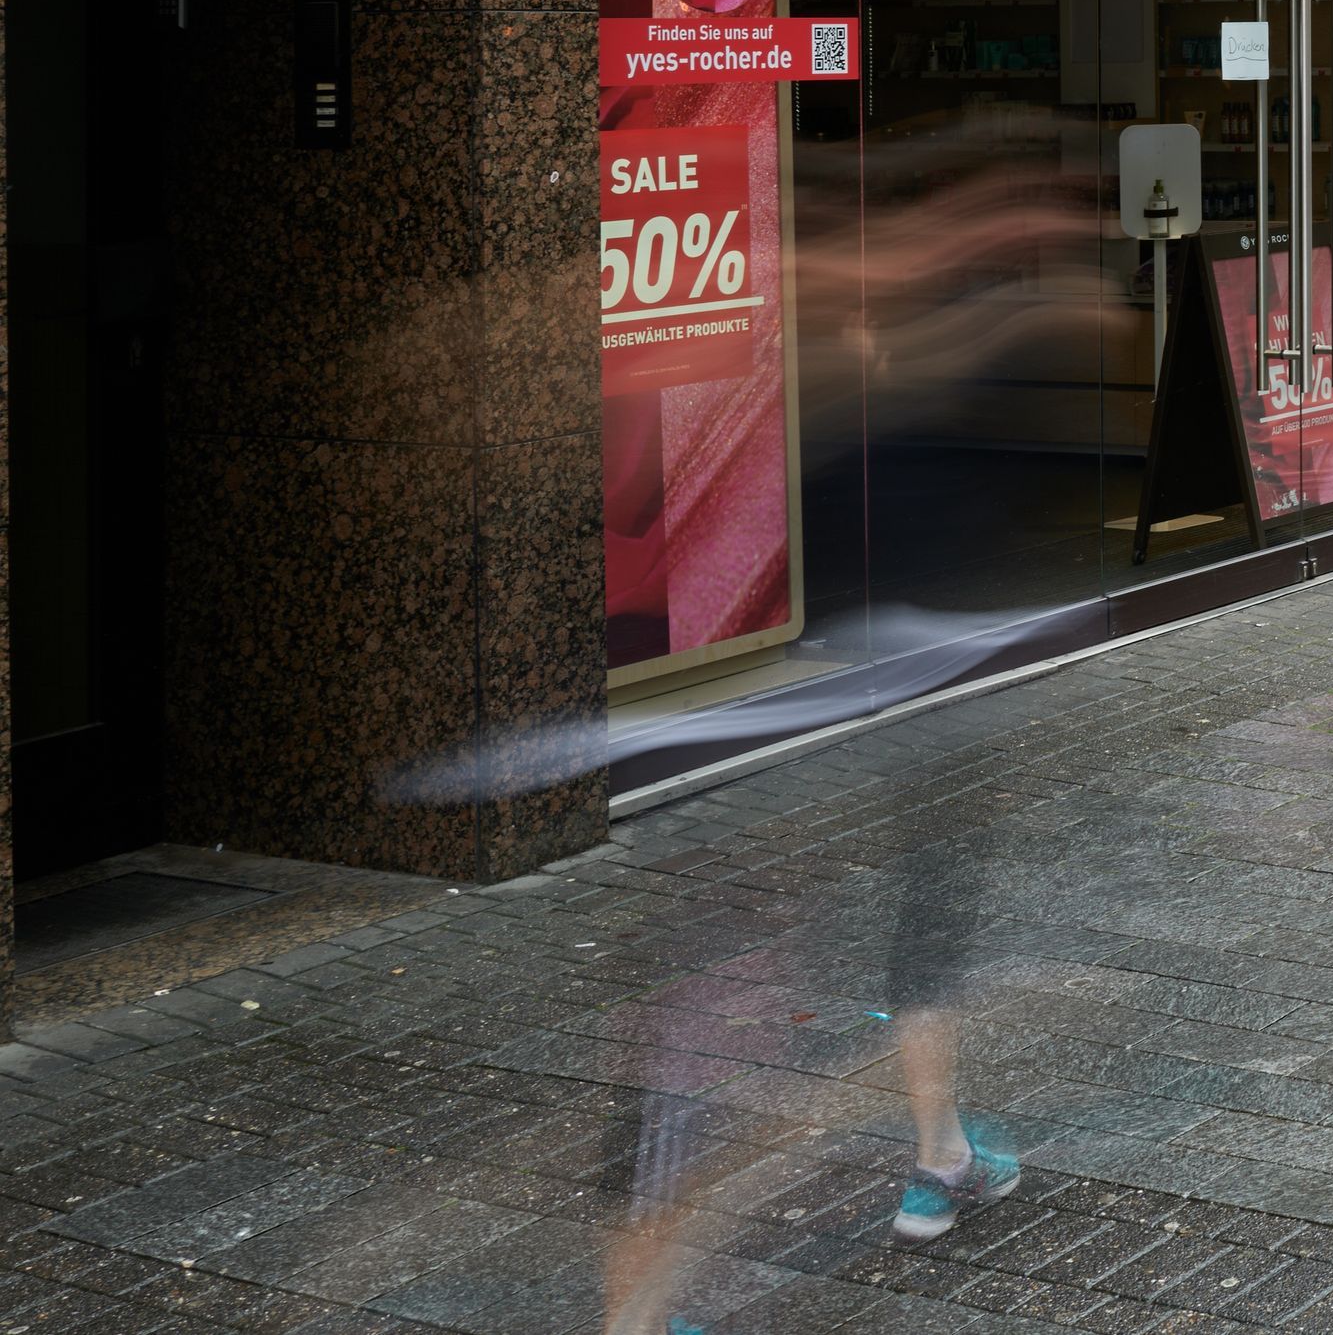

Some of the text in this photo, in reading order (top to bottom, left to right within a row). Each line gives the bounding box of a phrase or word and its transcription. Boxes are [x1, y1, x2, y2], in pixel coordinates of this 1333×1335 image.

[648, 24, 773, 41] Finden Sie uns auf
[626, 45, 792, 79] yves-rocher.de
[610, 153, 699, 195] SALE
[687, 317, 749, 341] PRODUKTE
[1274, 315, 1290, 332] WI
